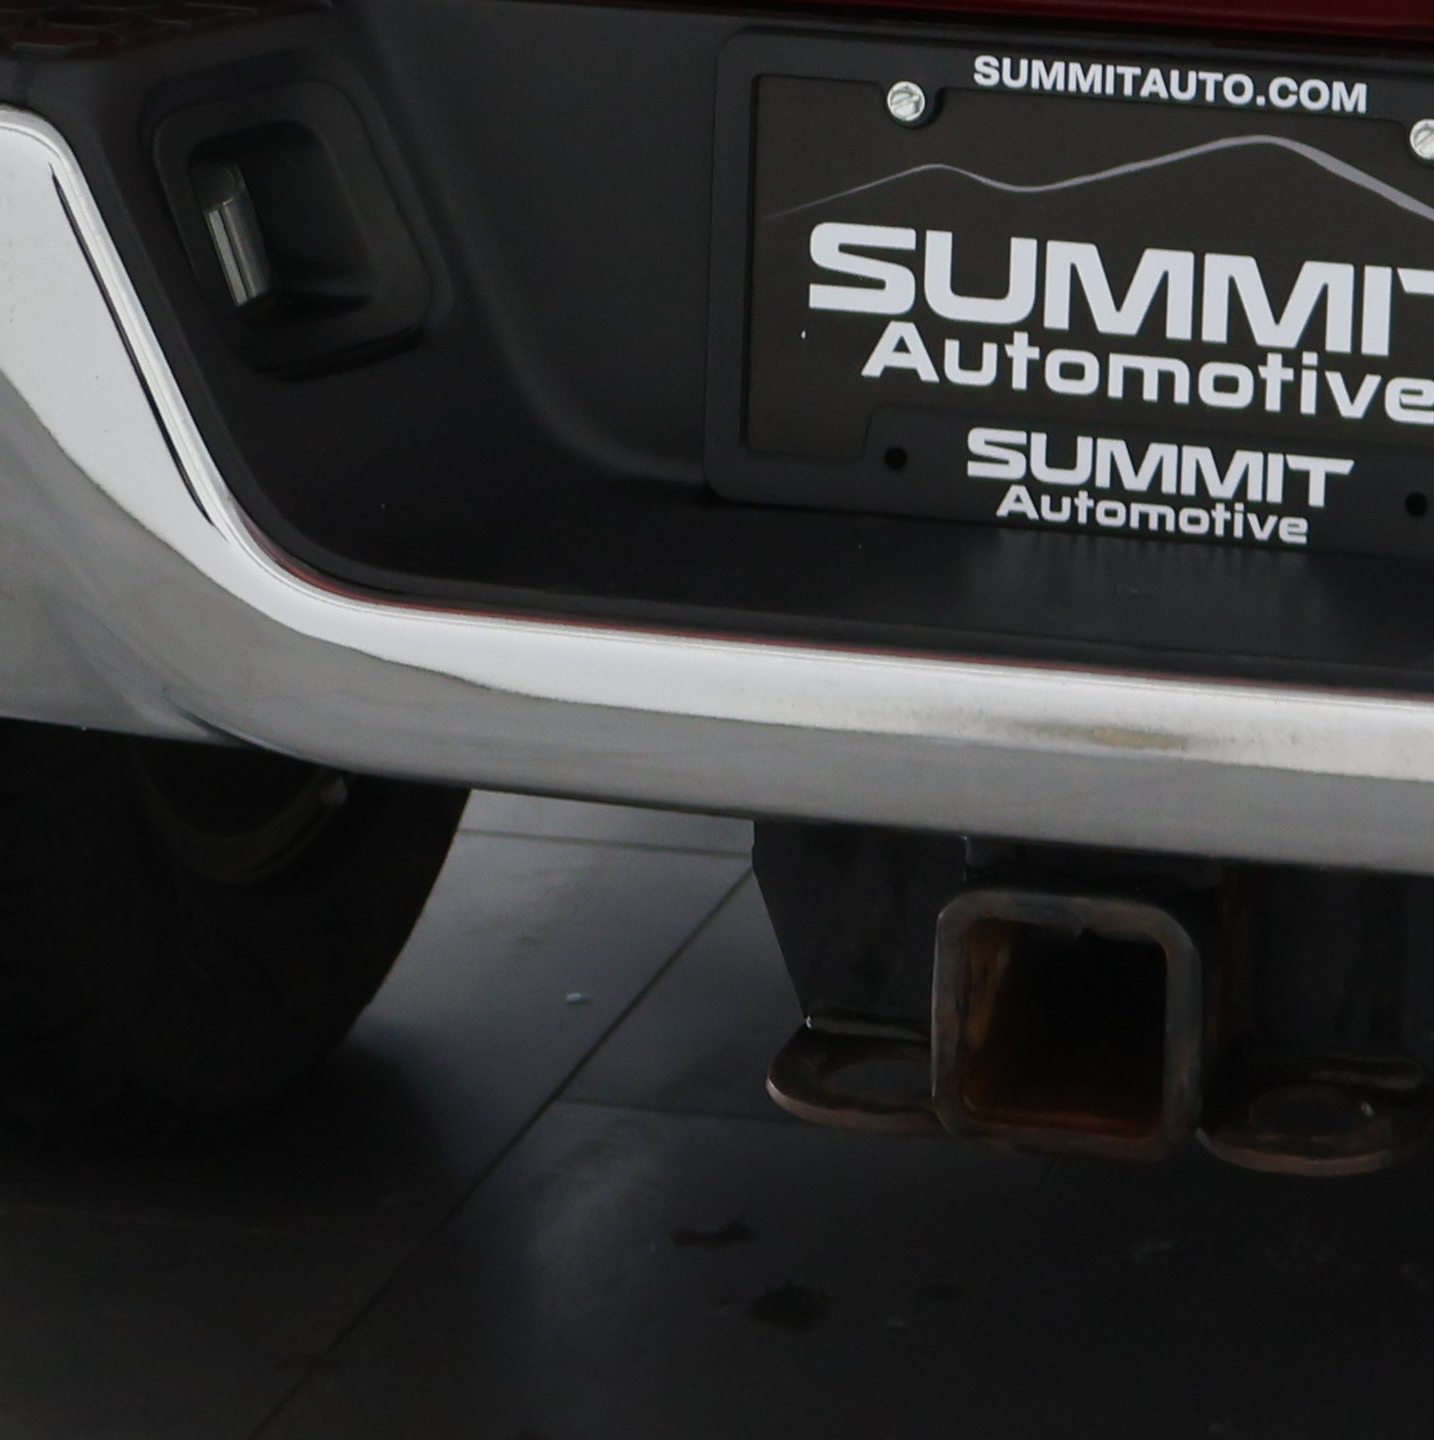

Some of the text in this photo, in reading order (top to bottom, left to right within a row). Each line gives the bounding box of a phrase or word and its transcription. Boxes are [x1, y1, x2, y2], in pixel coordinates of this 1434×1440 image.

[973, 54, 1367, 113] SUMMITAUTO.COM
[967, 426, 1354, 506] SUMMIT
[996, 484, 1308, 544] Automotive
